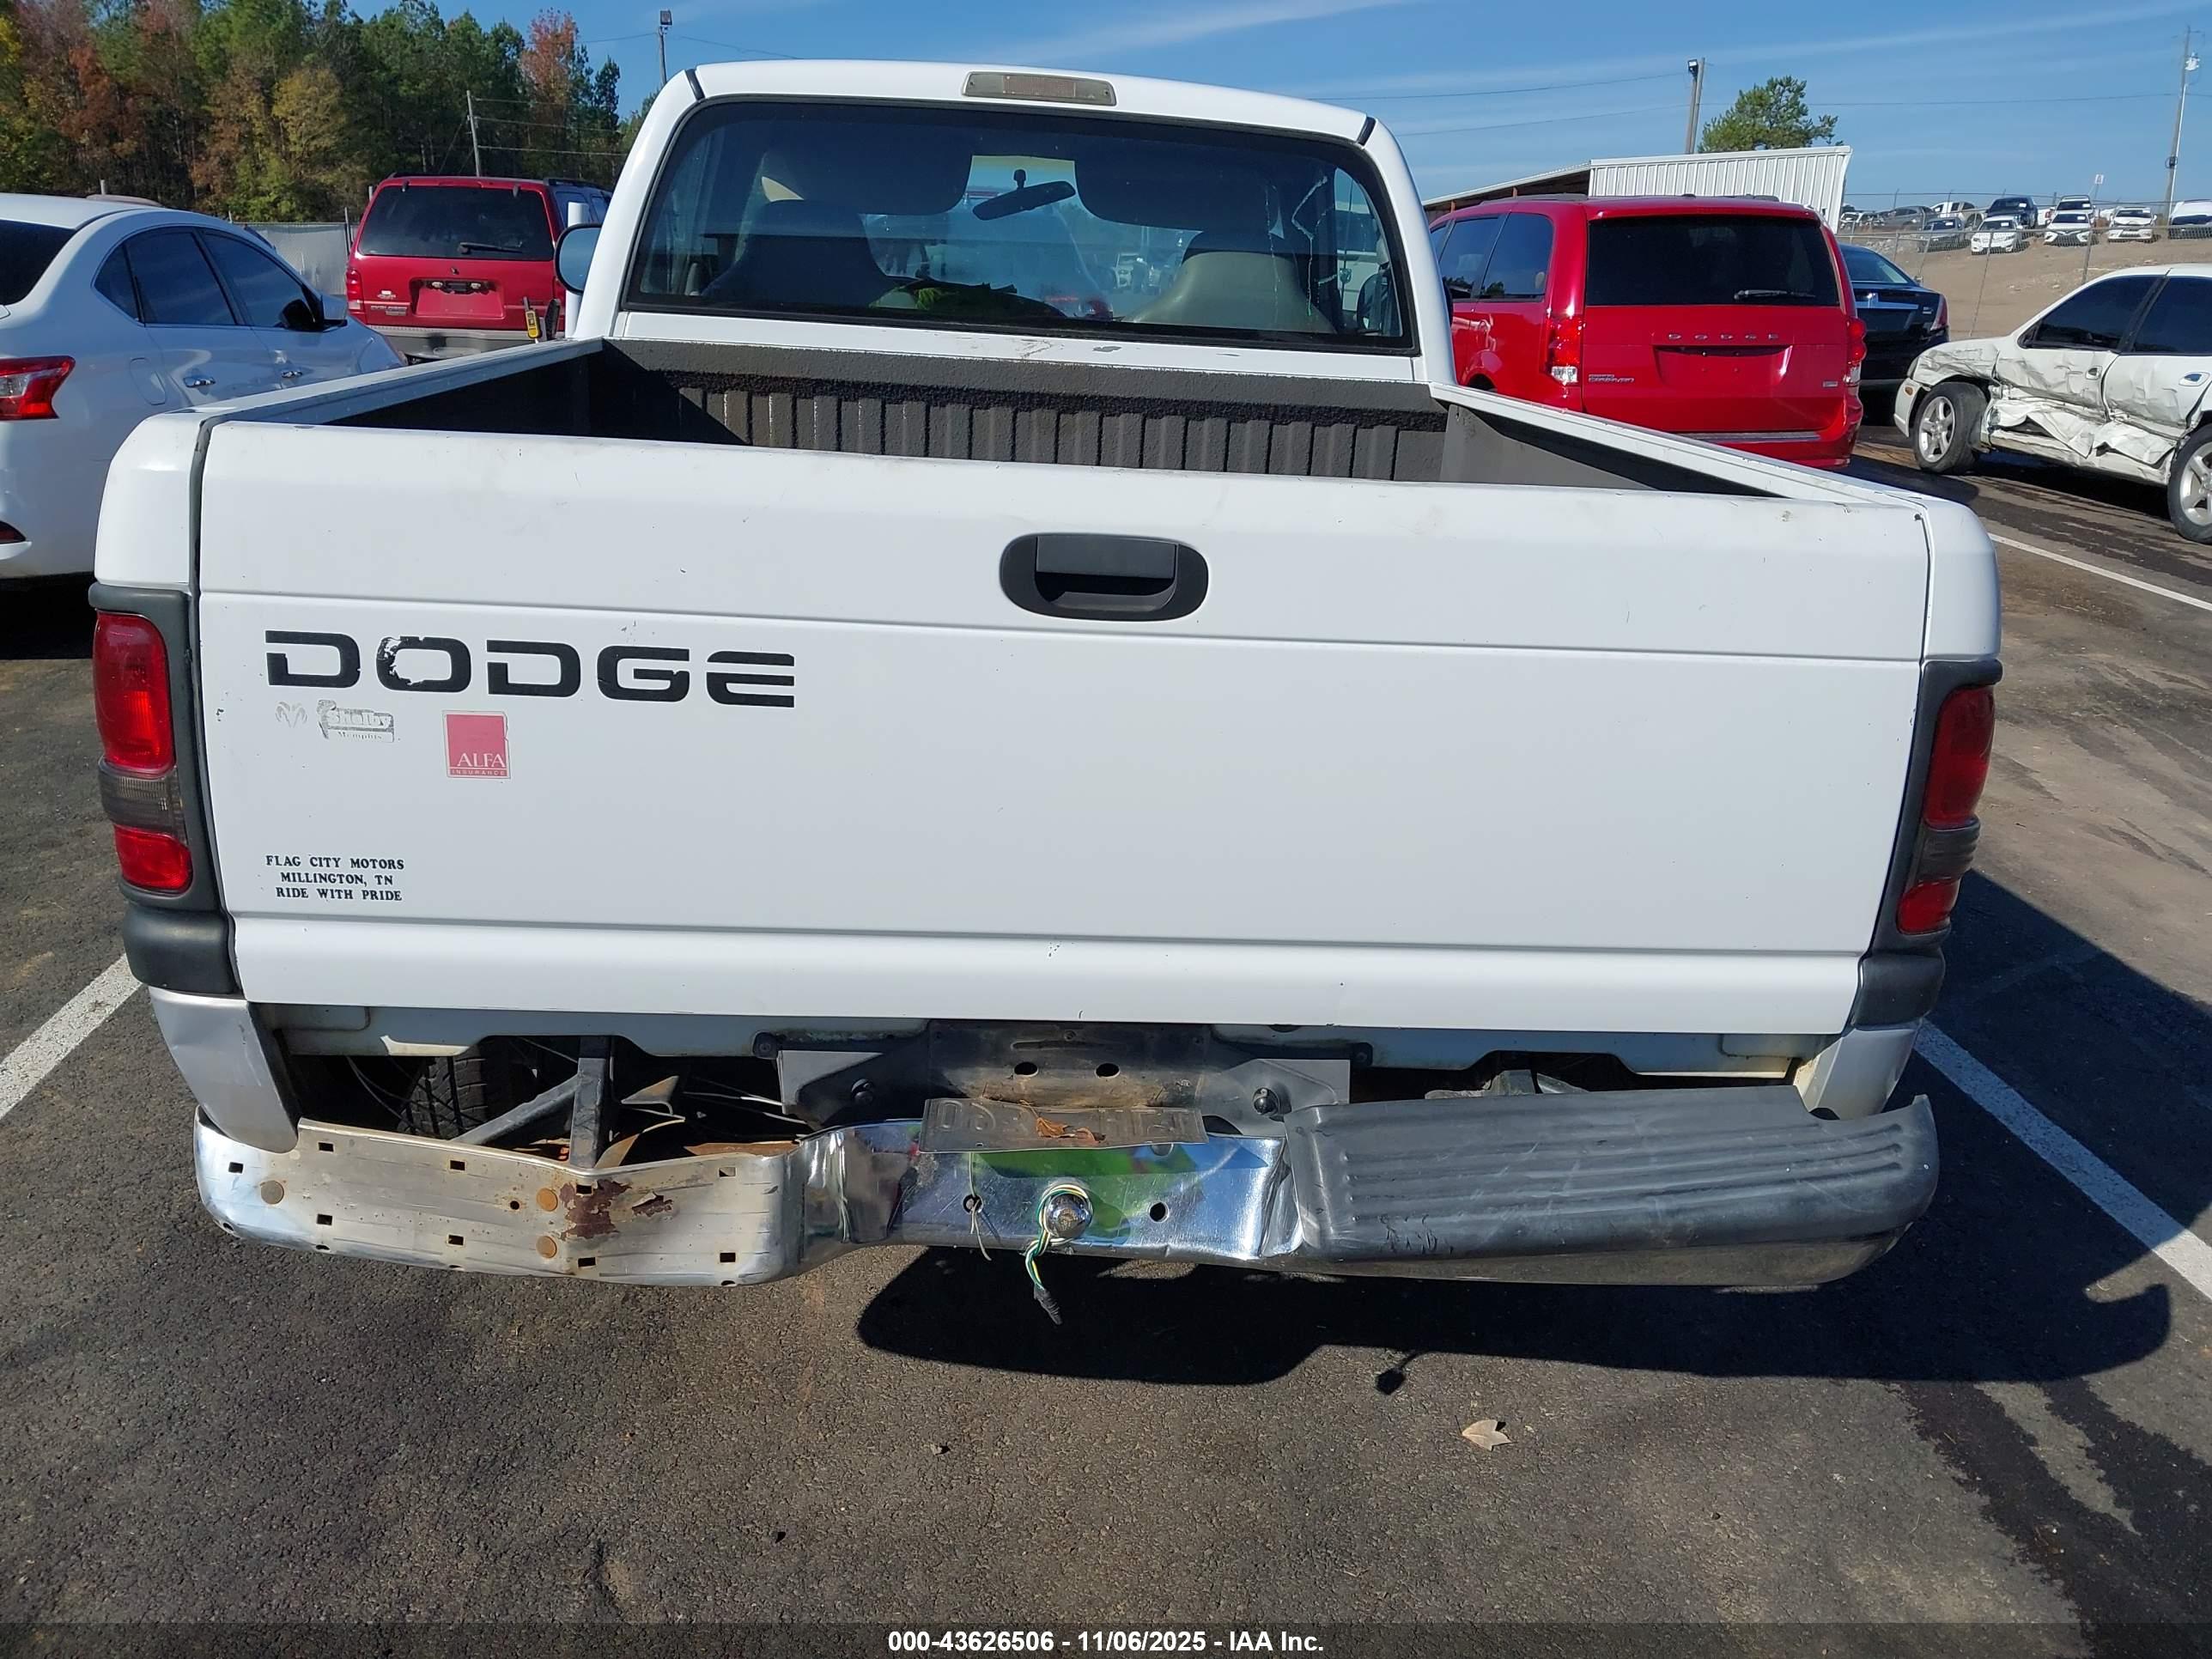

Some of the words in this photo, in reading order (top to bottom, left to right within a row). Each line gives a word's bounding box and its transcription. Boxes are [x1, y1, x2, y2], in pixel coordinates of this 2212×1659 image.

[265, 630, 795, 708] DODGE
[457, 752, 506, 768] ALFA
[265, 855, 301, 867] FLAG
[309, 857, 341, 868] CITY
[350, 858, 404, 870] MOTORS
[280, 872, 368, 887] MILLINGTON,
[374, 875, 393, 885] TN
[276, 887, 309, 899] RIDE
[317, 888, 354, 900] WITH
[362, 890, 403, 902] PRIDE
